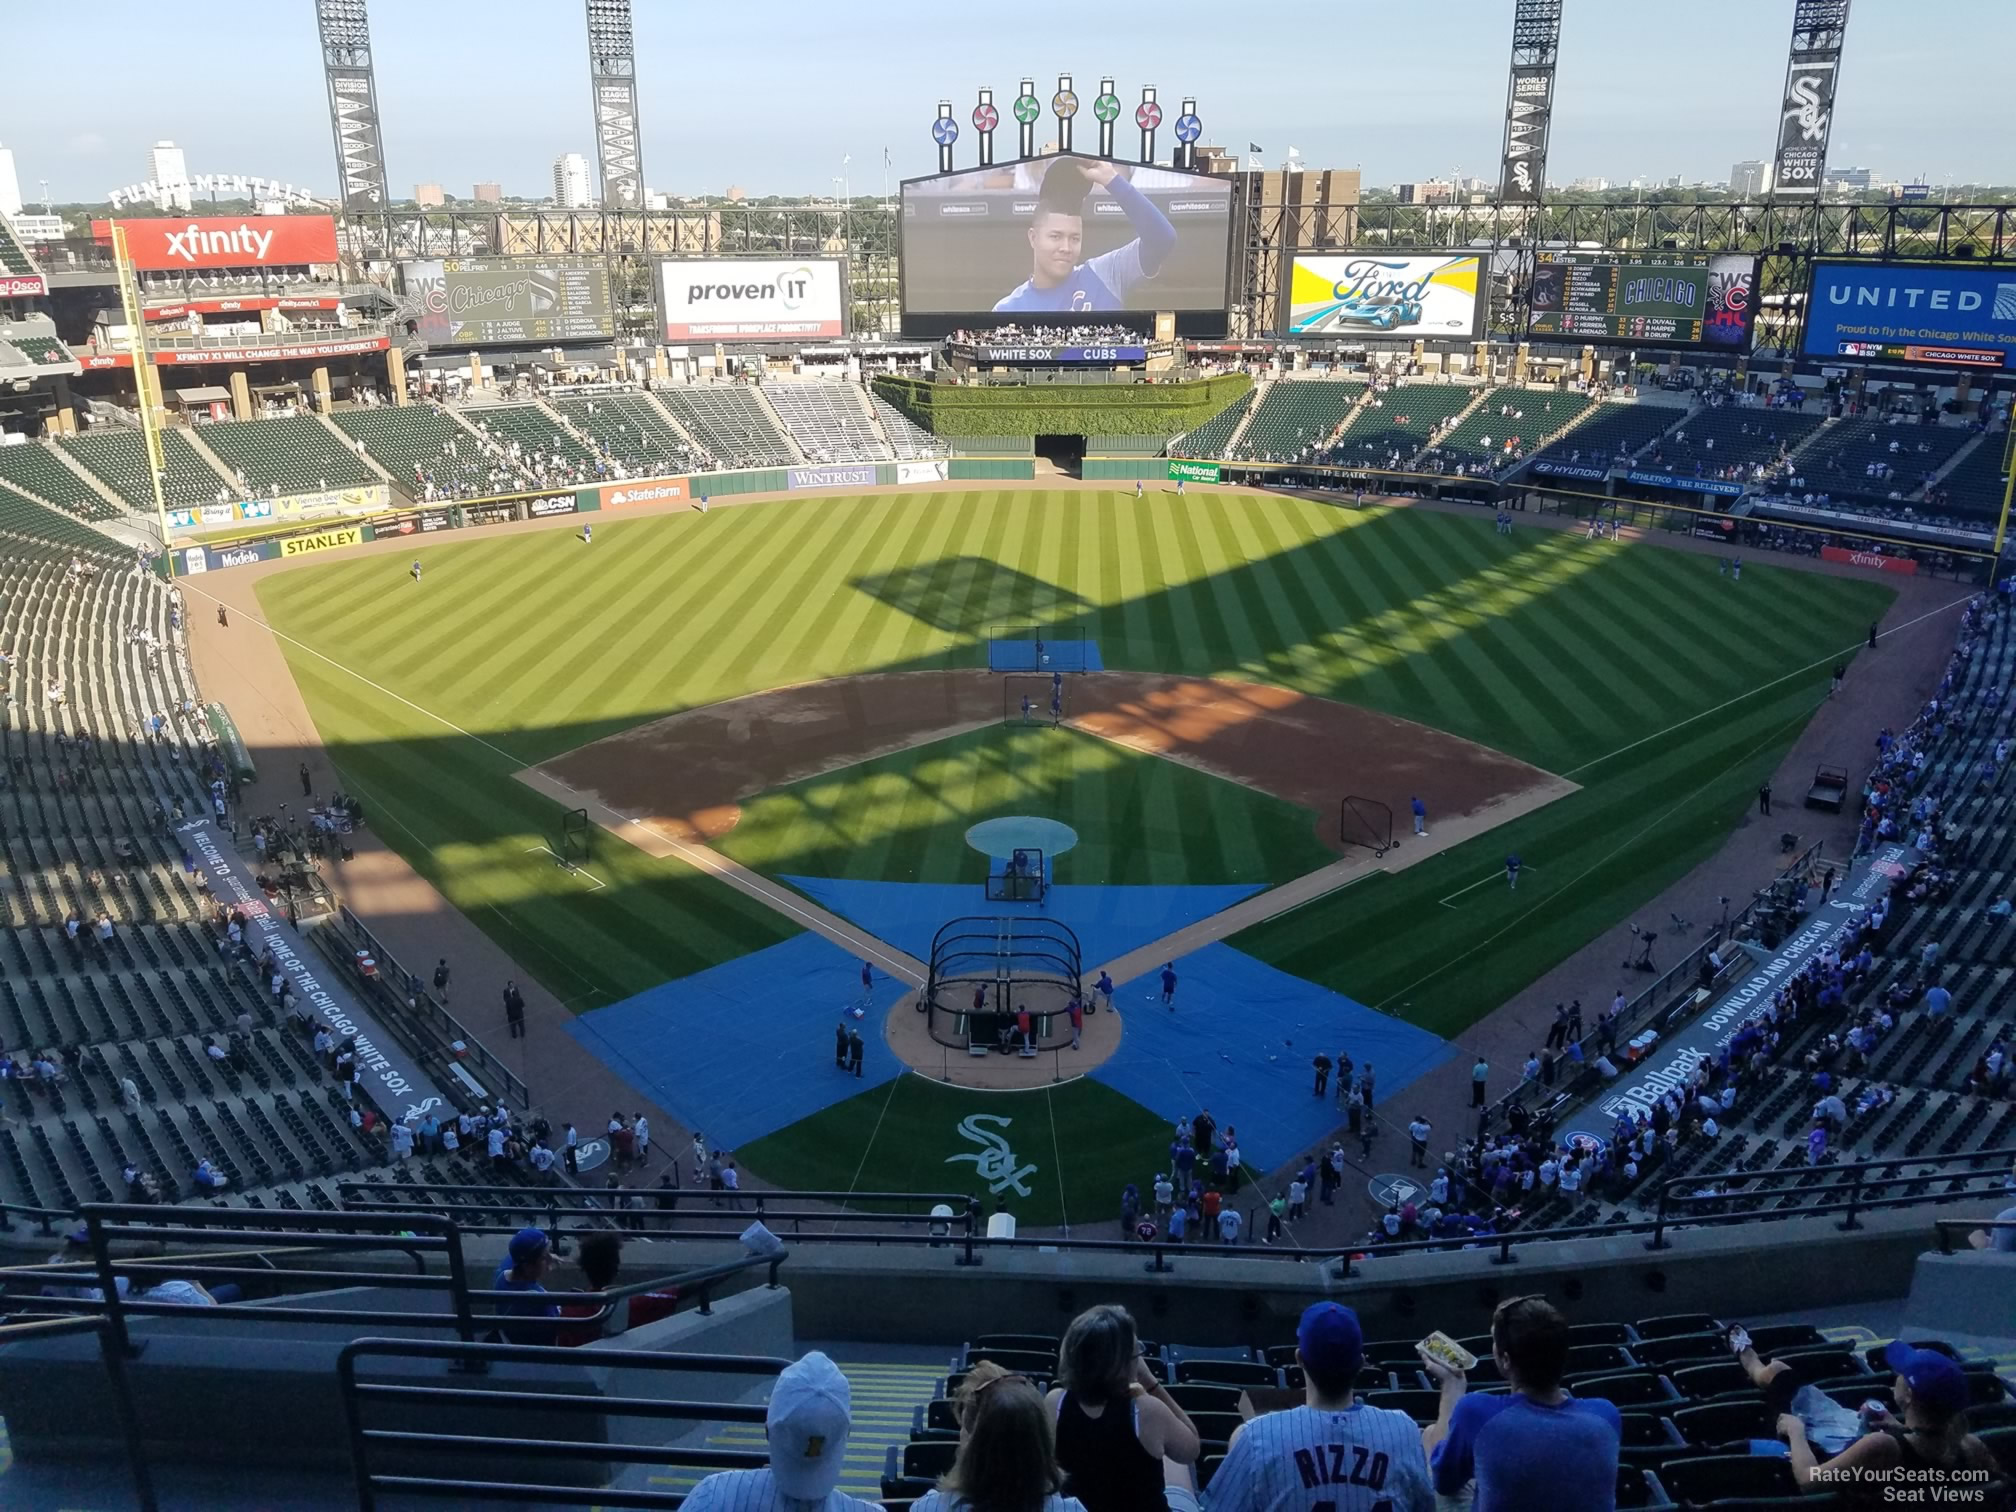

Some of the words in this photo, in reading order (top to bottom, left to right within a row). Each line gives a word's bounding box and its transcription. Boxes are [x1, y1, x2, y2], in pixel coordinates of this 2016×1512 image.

[1782, 167, 1816, 179] SOX
[108, 174, 312, 210] FUNDAMENTALS
[1171, 203, 1225, 211] loswhitesox.com
[164, 224, 273, 262] xfinity
[1538, 253, 1552, 262] 34
[444, 262, 459, 272] 50
[1333, 260, 1434, 302] Ford
[450, 279, 528, 313] Chicago
[688, 283, 775, 304] proven
[788, 280, 806, 298] IT
[1625, 278, 1696, 308] CHICAGO
[1829, 286, 1982, 311] UNITED
[220, 301, 241, 309] xfinity
[1836, 324, 1867, 334] Proud
[1869, 325, 1880, 335] to
[1882, 326, 1896, 338] fly
[1898, 328, 1916, 337] the
[1918, 329, 1959, 341] Chicago
[1962, 331, 1995, 342] White
[1997, 333, 2016, 344] Sox
[176, 353, 209, 361] XFINITY
[222, 351, 244, 360] WILL
[246, 349, 281, 358] CHANGE
[282, 348, 298, 356] THE
[299, 347, 317, 355] WAY
[318, 346, 333, 354] YOU
[333, 342, 369, 353] EXPERIENCE
[988, 349, 1026, 360] WHITE
[1029, 349, 1052, 360] SOX
[1083, 349, 1116, 360] CUBS
[89, 357, 115, 366] xfinity
[794, 471, 870, 485] WINTRUST
[1342, 471, 1366, 479] PATIO
[1553, 465, 1603, 479] HYUNDAI
[1629, 471, 1672, 484] ATHLETICO
[1677, 479, 1693, 487] THE
[1694, 481, 1740, 494] RELIEVERS
[294, 494, 322, 506] Vienna
[323, 493, 341, 504] Beef
[547, 496, 575, 509] CSN
[203, 507, 224, 516] Bring
[286, 531, 356, 554] STANLEY
[187, 554, 204, 562] Modelo
[221, 551, 259, 568] Modelo
[1850, 553, 1886, 569] xfinity
[1881, 847, 1904, 863] Field
[192, 831, 225, 866] WELCOME
[214, 864, 231, 875] TO
[223, 876, 256, 903] guaranteed
[1872, 862, 1892, 873] Rate
[1852, 872, 1883, 899] guaranteed
[245, 900, 262, 915] Rate
[254, 913, 280, 931] Field
[1702, 976, 1770, 1031] DOWNLOAD
[1762, 957, 1790, 978] AND
[264, 934, 295, 960] HOME
[284, 959, 305, 976] OF
[295, 971, 320, 992] THE
[310, 990, 358, 1035] CHICAGO
[354, 1034, 390, 1072] WHITE
[380, 1071, 413, 1096] SOX
[1625, 1046, 1710, 1104] Ballpark
[1141, 1227, 1152, 1236] 72
[1293, 1444, 1389, 1491] RIZZO
